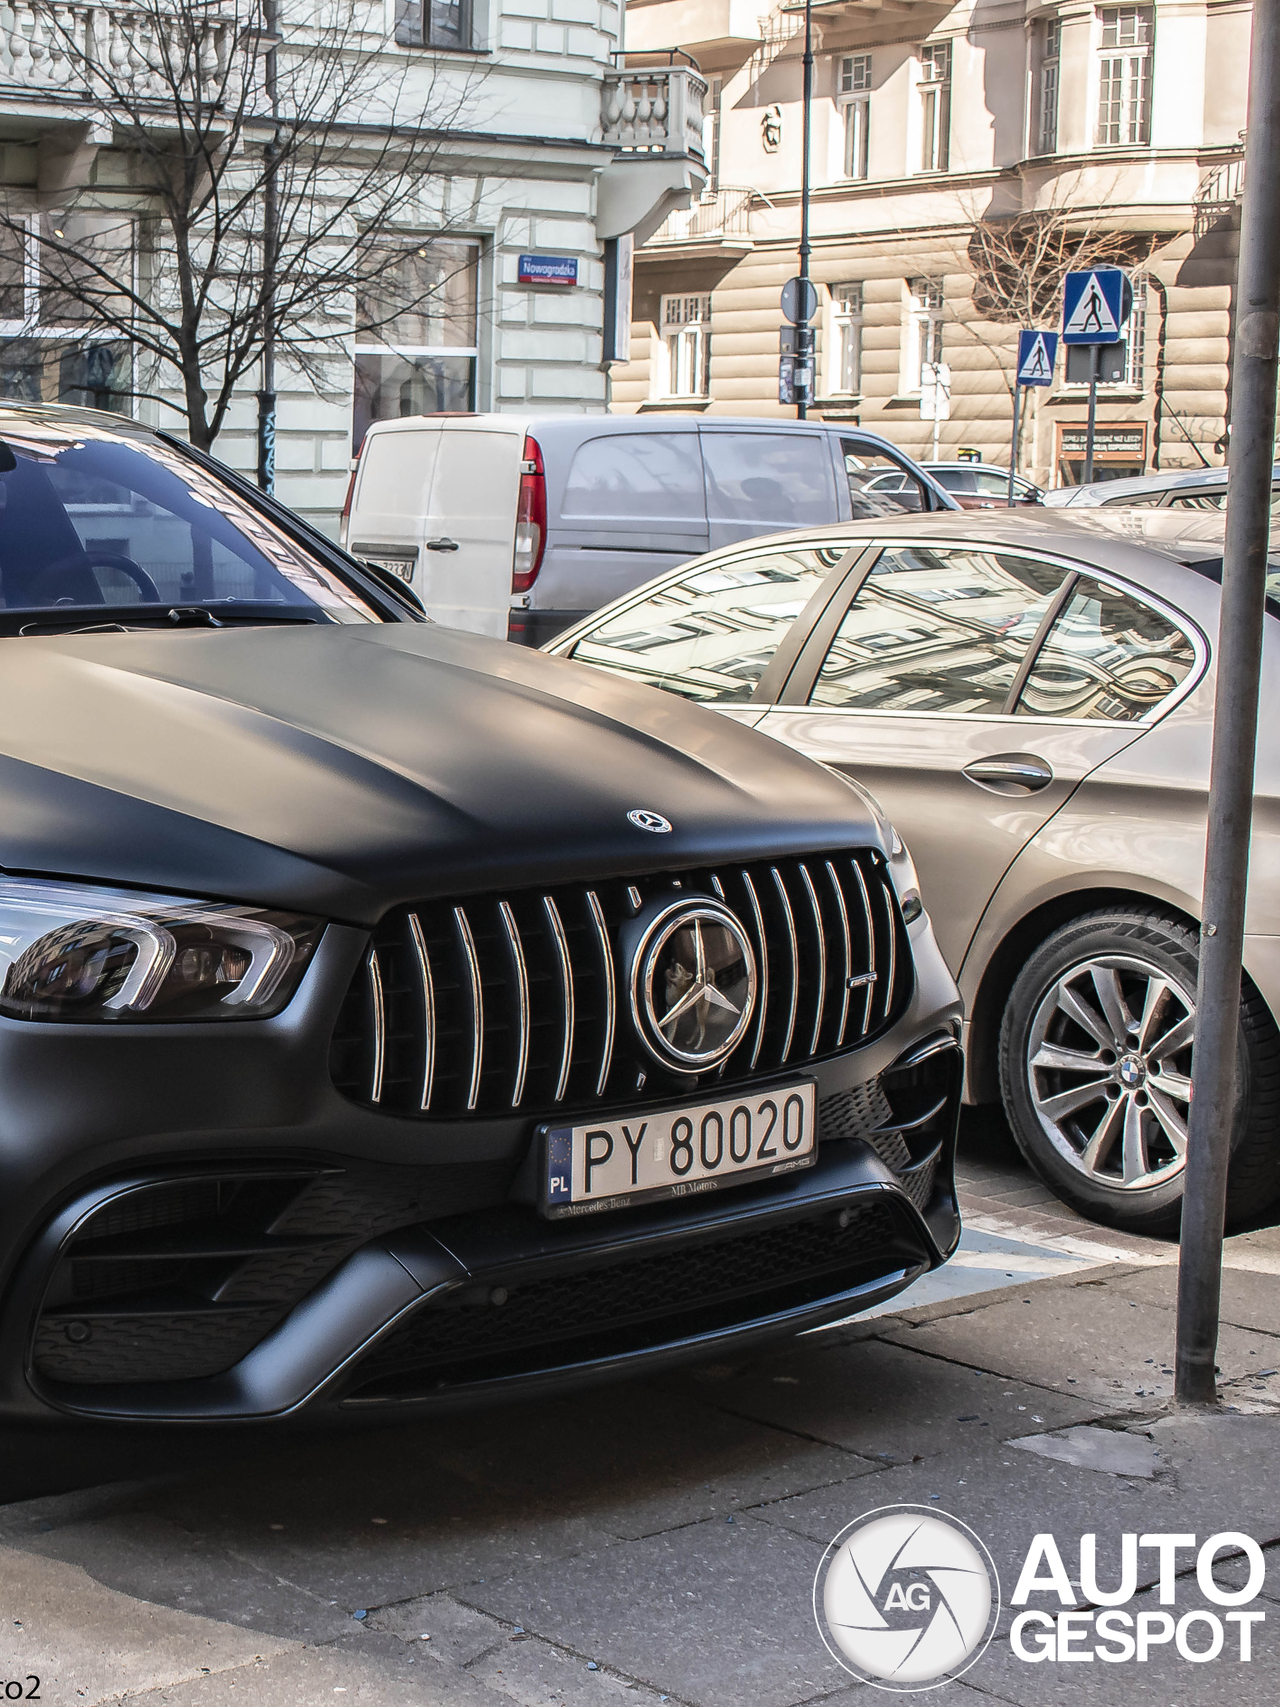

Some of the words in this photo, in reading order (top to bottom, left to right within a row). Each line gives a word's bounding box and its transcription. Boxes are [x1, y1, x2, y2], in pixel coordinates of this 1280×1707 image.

[523, 262, 576, 277] Nowogrodzka
[583, 1121, 649, 1194] PY
[668, 1092, 806, 1177] 80020
[549, 1176, 569, 1195] PL
[567, 1197, 631, 1217] Mercedes-Benz
[670, 1184, 687, 1198] MB
[687, 1179, 718, 1195] Motors
